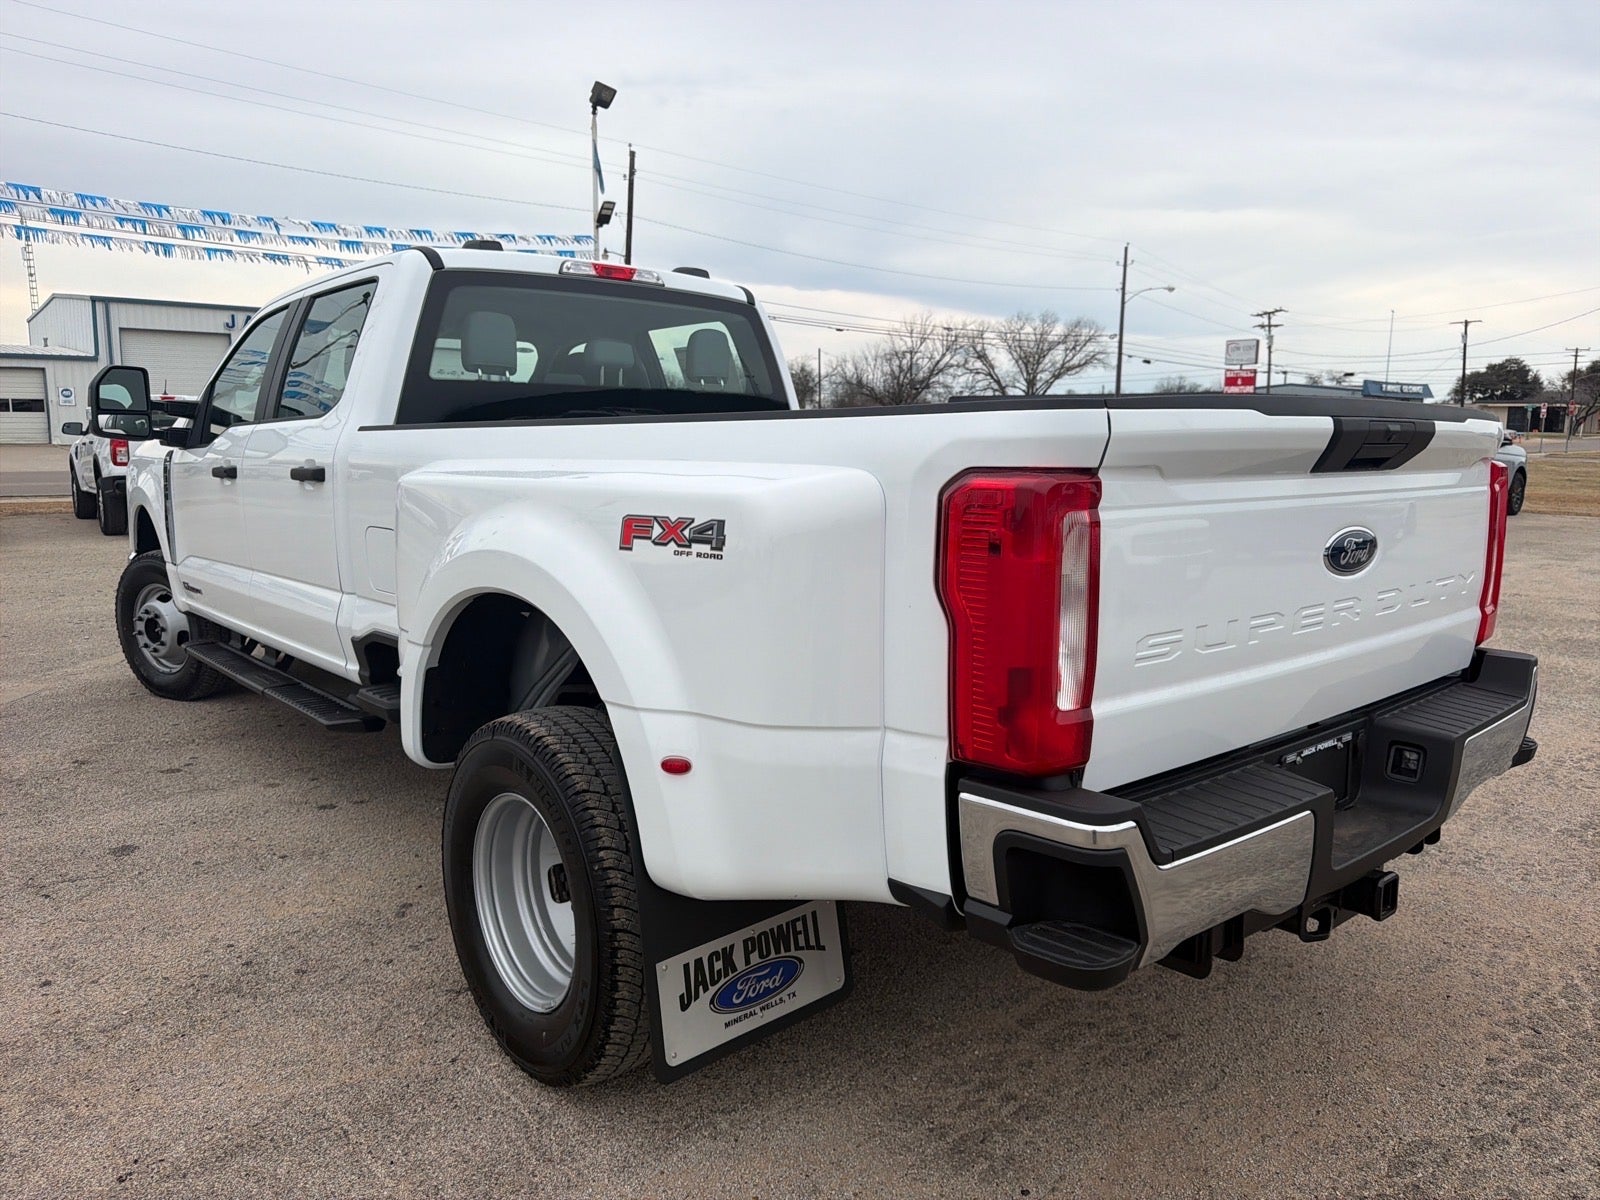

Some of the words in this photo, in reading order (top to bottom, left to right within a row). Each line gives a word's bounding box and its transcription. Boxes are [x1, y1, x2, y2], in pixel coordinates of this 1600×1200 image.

[618, 513, 726, 552] FX4
[1339, 537, 1371, 566] Ford
[673, 549, 693, 558] OFF
[696, 551, 724, 561] ROAD
[1134, 595, 1364, 668] SUPER
[1375, 570, 1476, 617] DUTY
[1301, 745, 1317, 757] JACK
[1316, 738, 1338, 752] POWELL
[678, 944, 738, 1013] JACK
[743, 910, 826, 966] POWELL
[732, 966, 784, 1004] Ford
[724, 1009, 758, 1030] MINERAL
[759, 997, 786, 1013] WELLS,
[787, 990, 797, 1000] TX
